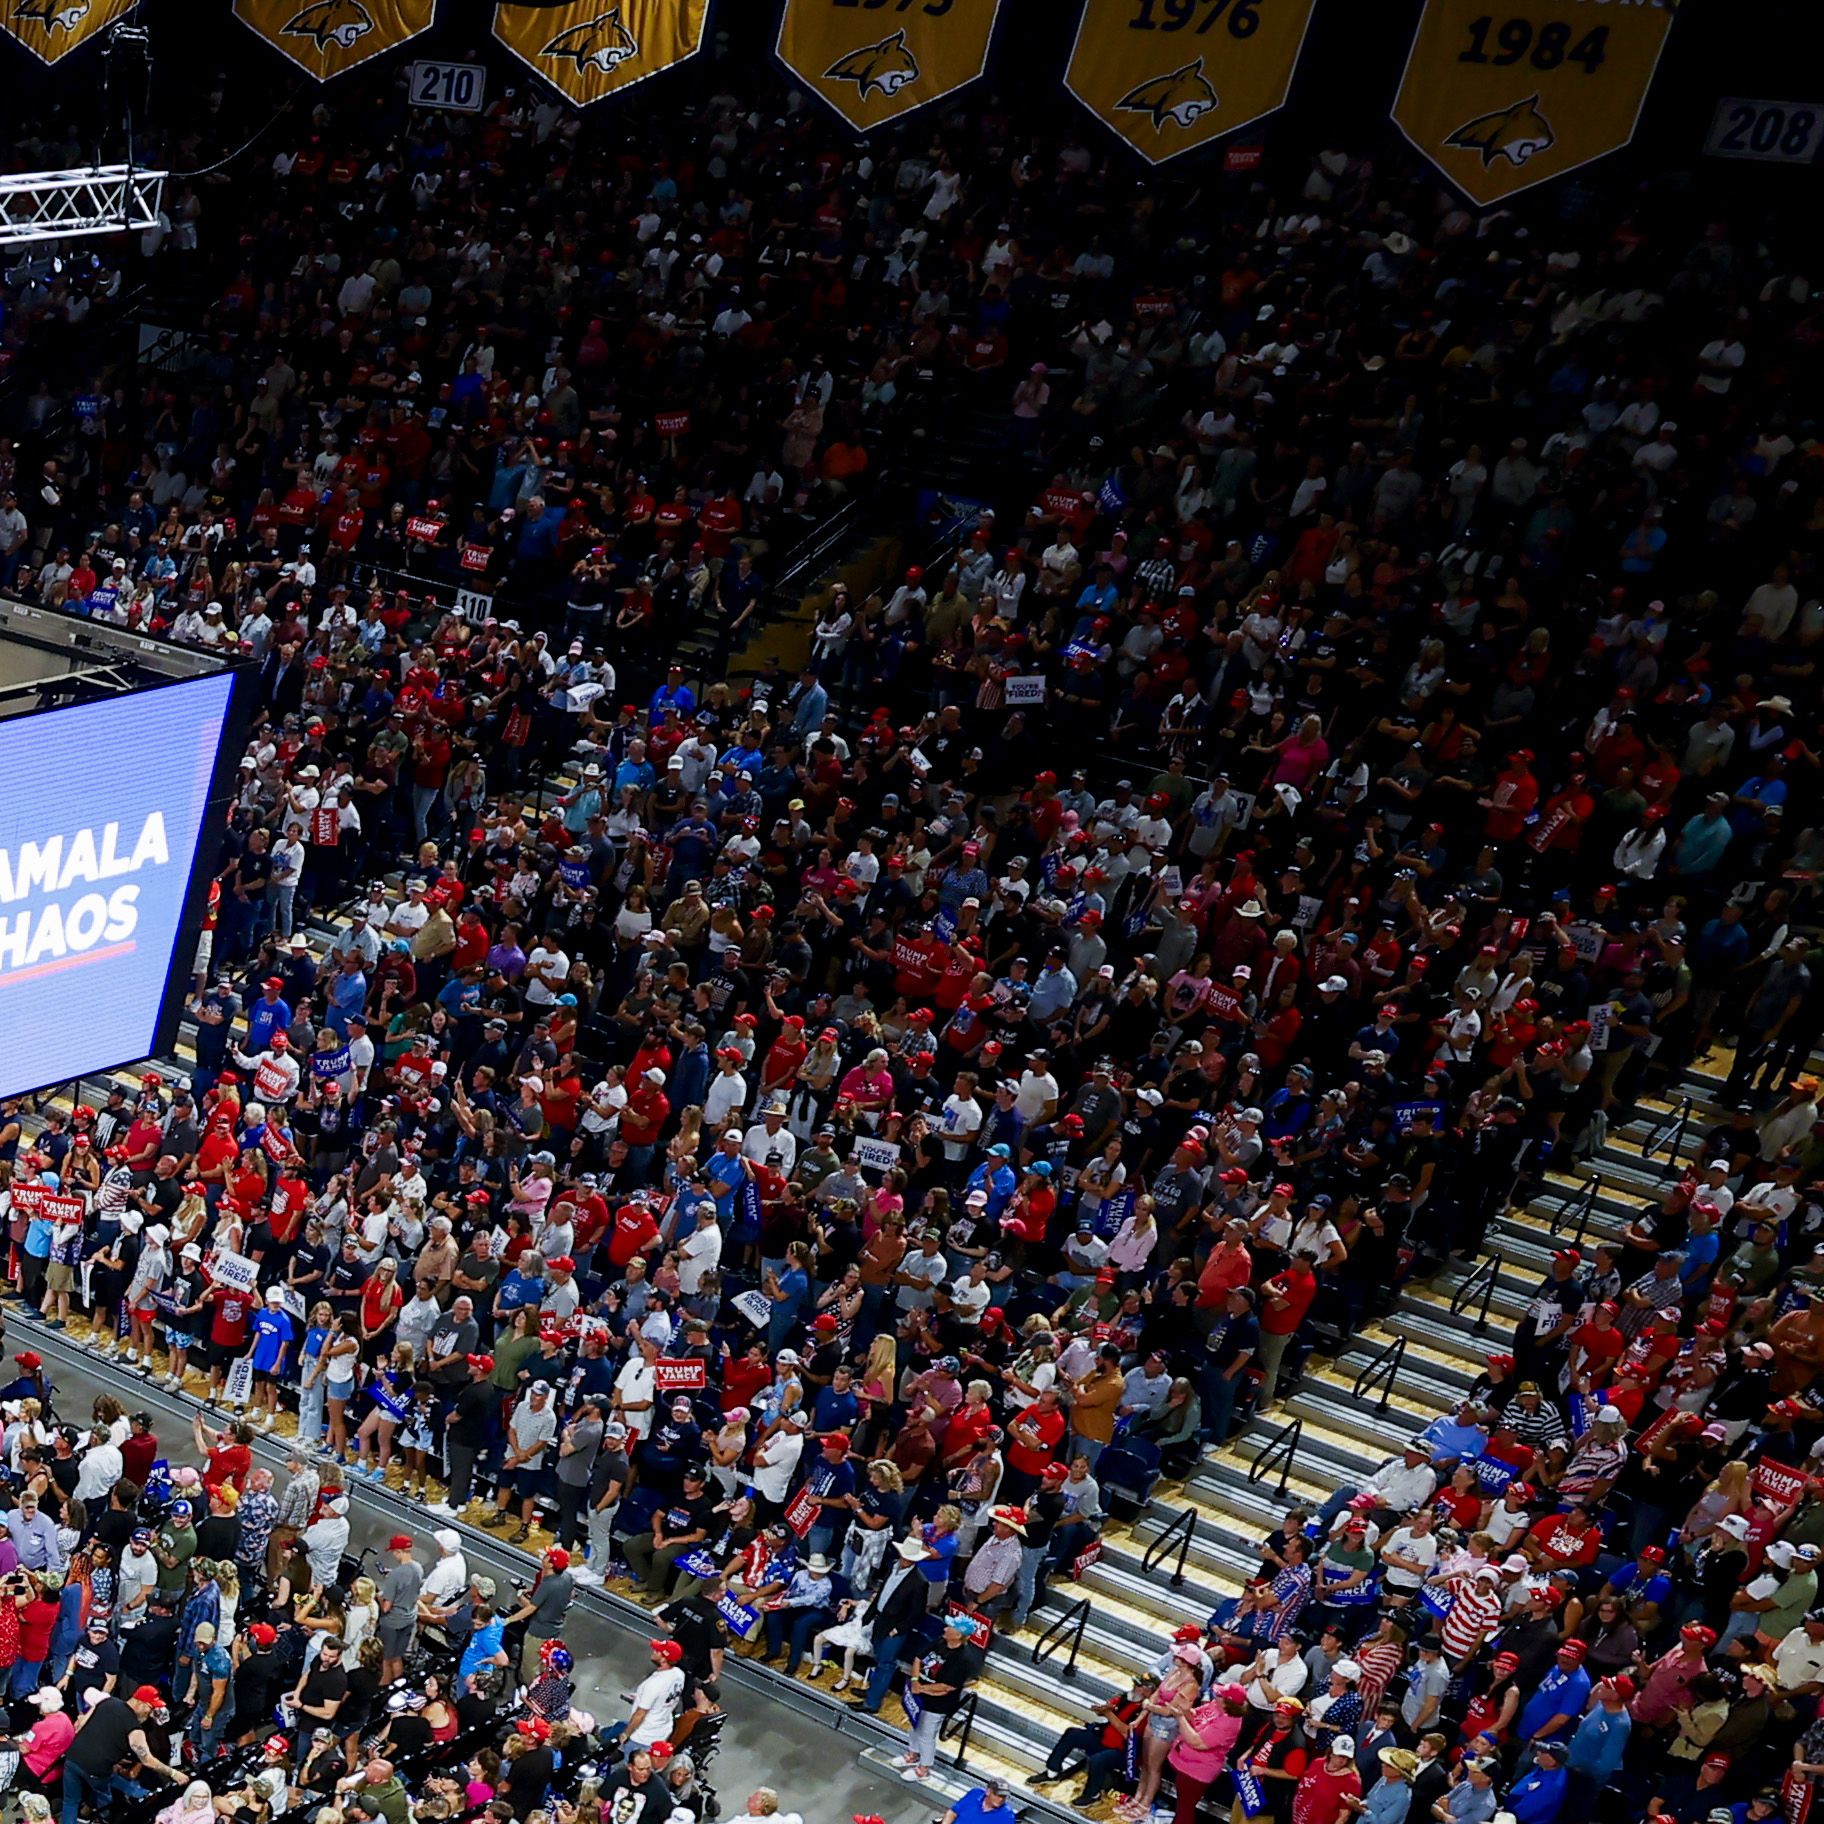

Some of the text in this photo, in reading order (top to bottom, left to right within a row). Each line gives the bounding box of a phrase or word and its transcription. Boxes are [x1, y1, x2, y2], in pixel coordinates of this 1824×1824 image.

[1128, 0, 1259, 39] 1976
[1457, 15, 1610, 74] 1984
[420, 63, 473, 105] 210
[1719, 100, 1815, 154] 208
[460, 594, 486, 623] 110
[1008, 689, 1040, 698] FIRED!
[895, 943, 926, 961] TRUMP
[896, 951, 923, 966] VANCE
[316, 1053, 348, 1065] TRUMP
[320, 1061, 345, 1070] VANCE
[260, 1065, 290, 1078] TRUMP
[858, 1151, 894, 1164] FIRED!
[862, 1144, 892, 1156] YOU'RE
[43, 1200, 80, 1212] TRUMP
[49, 1209, 75, 1217] VANCE
[1114, 1195, 1126, 1233] TRUMP
[224, 1261, 251, 1274] YOU'RE
[1475, 1460, 1510, 1479] TRUMP
[1478, 1467, 1504, 1483] VANCE
[1758, 1464, 1801, 1487] TRUMP
[1760, 1473, 1791, 1494] VANCE
